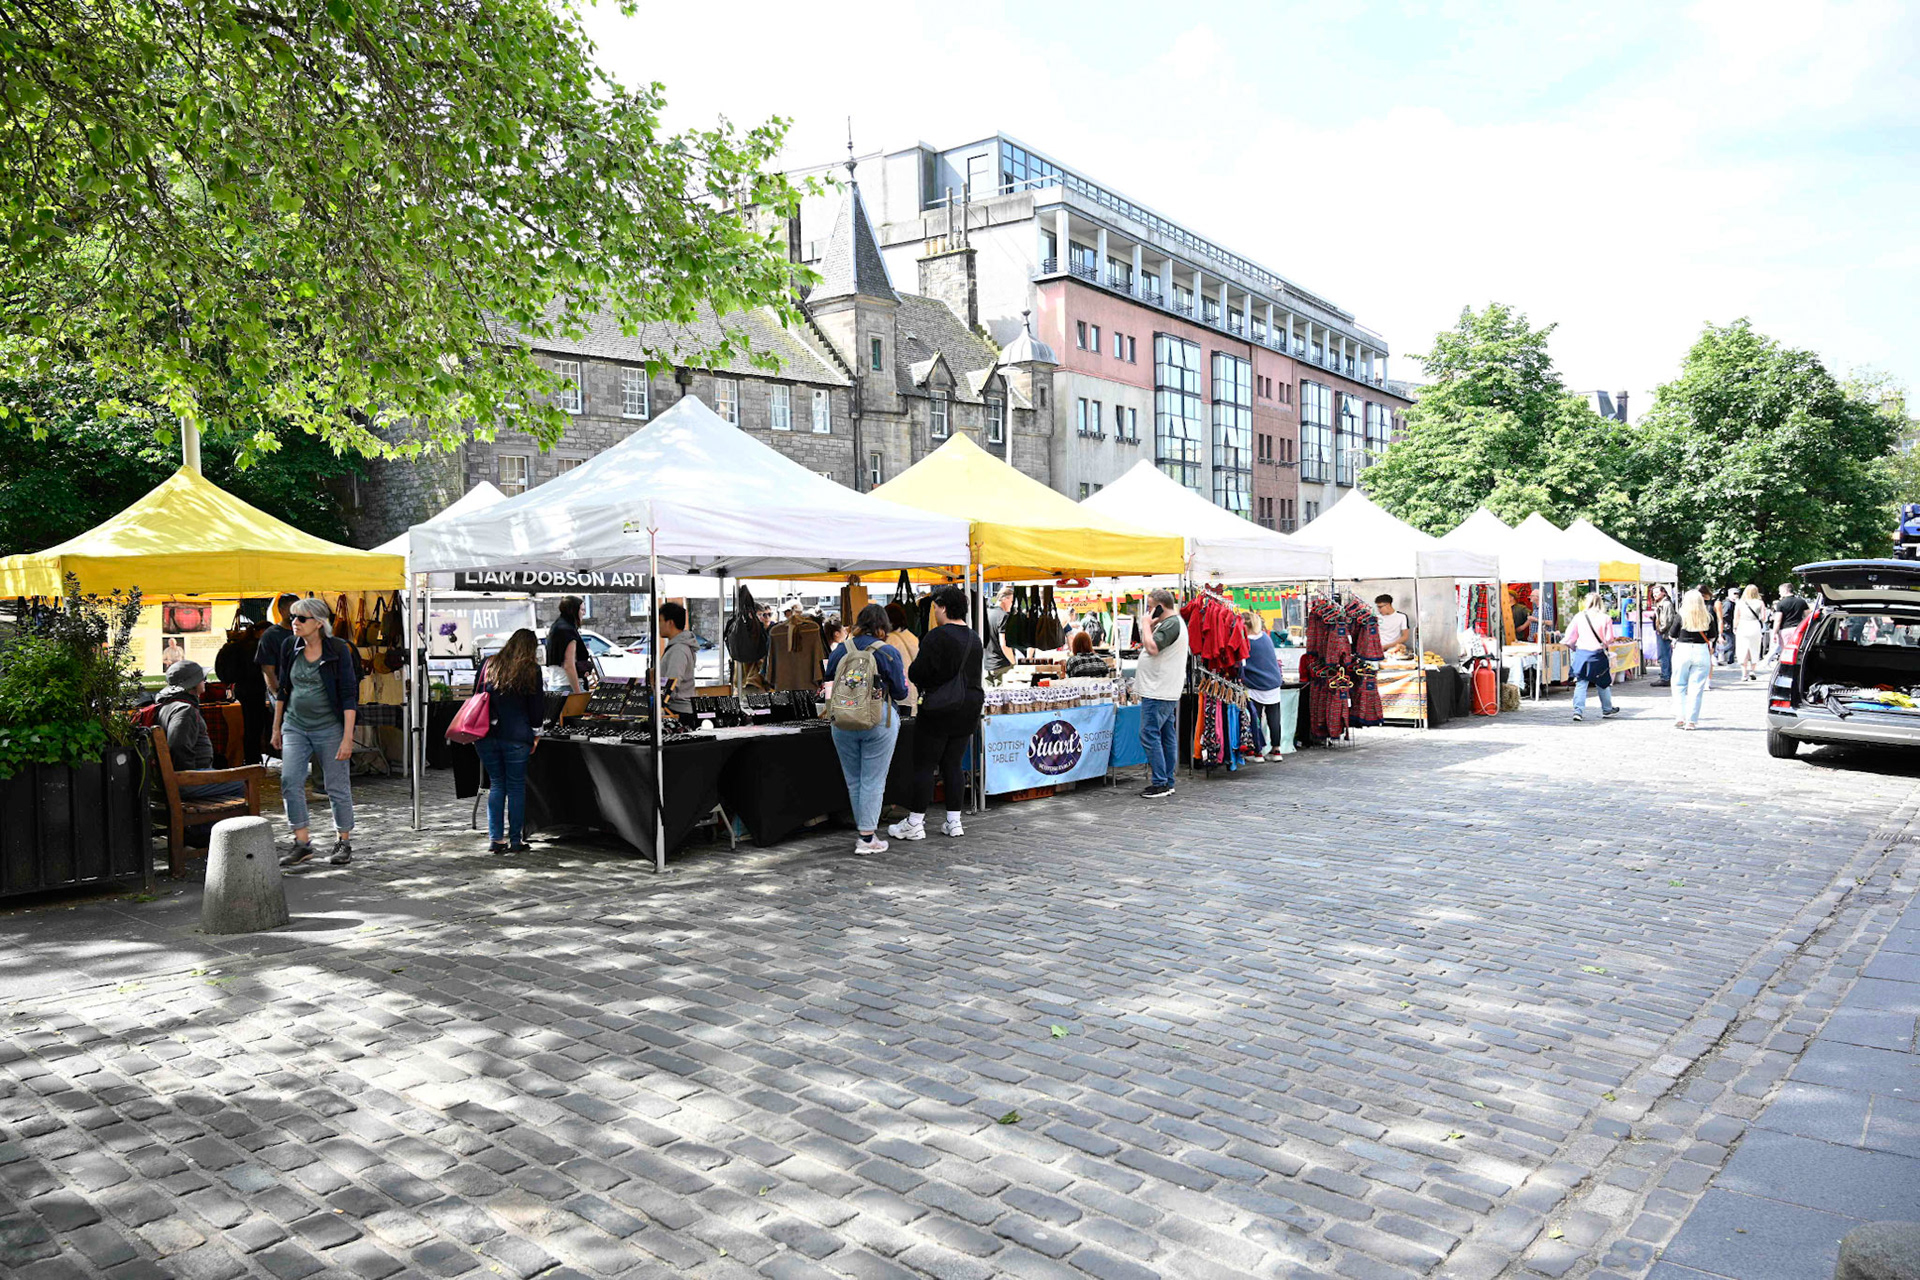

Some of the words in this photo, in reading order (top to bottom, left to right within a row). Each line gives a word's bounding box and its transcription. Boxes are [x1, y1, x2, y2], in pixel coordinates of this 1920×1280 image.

[464, 571, 516, 585] LIAM
[522, 572, 605, 587] DOBSON
[610, 573, 646, 587] ART
[472, 608, 500, 629] ART
[1084, 731, 1113, 741] SCOTTISH
[988, 741, 1025, 752] SCOTTISH
[1026, 731, 1084, 758] Stuart's
[1089, 741, 1109, 752] FUDGE
[992, 752, 1019, 763] TABLET
